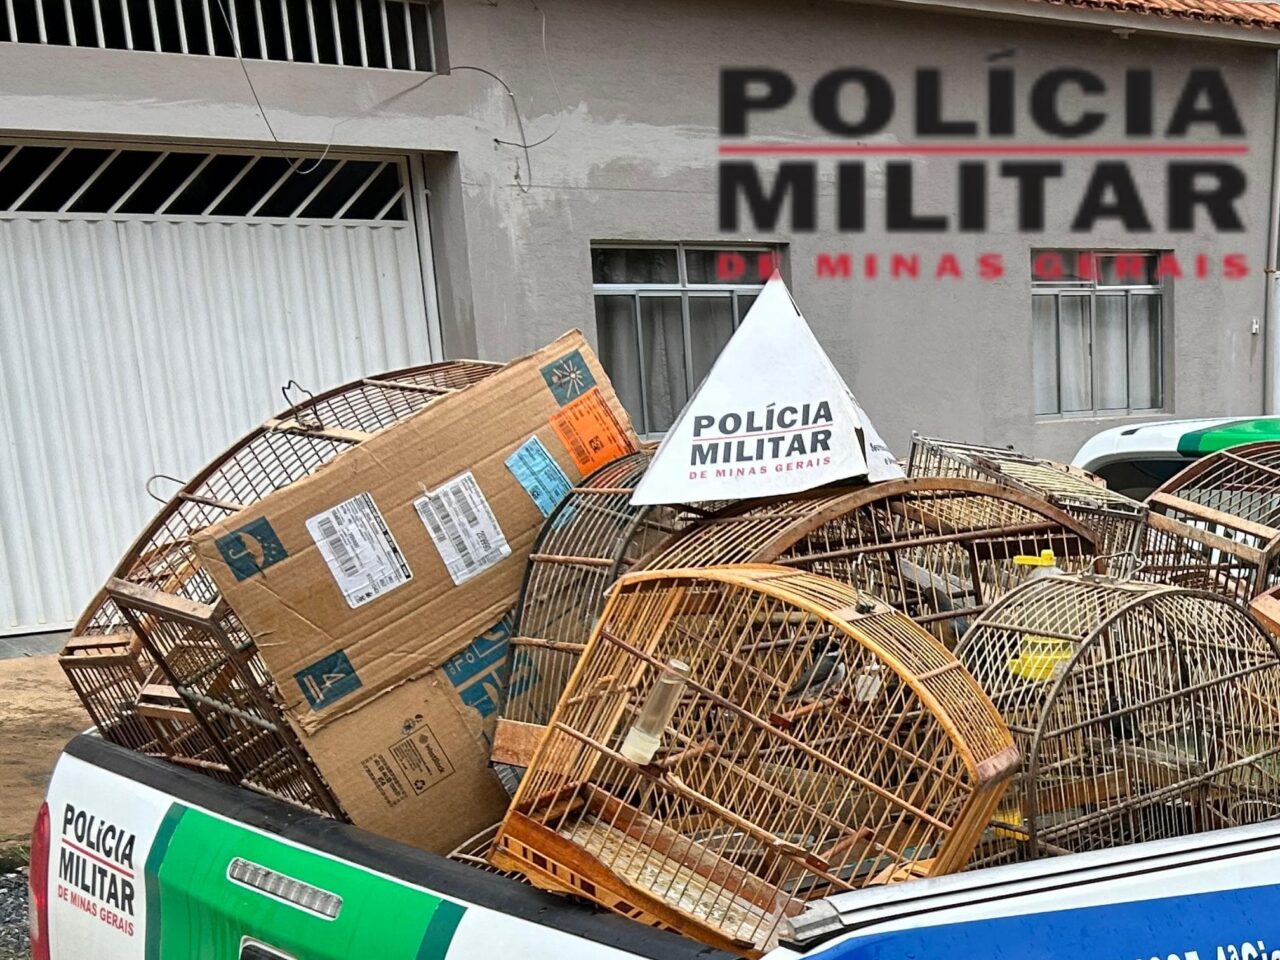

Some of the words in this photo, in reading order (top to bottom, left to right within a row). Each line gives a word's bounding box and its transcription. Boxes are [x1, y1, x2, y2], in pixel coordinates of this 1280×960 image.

[692, 401, 834, 438] POLÍCIA
[689, 470, 707, 480] DE
[716, 466, 768, 478] MINAS
[775, 457, 831, 472] GERAIS
[690, 430, 832, 466] MILITAR
[62, 802, 136, 870] POLÍCIA
[59, 846, 135, 917] MILITAR
[57, 884, 69, 901] DE
[70, 891, 98, 917] MINAS
[99, 907, 134, 937] GERAIS
